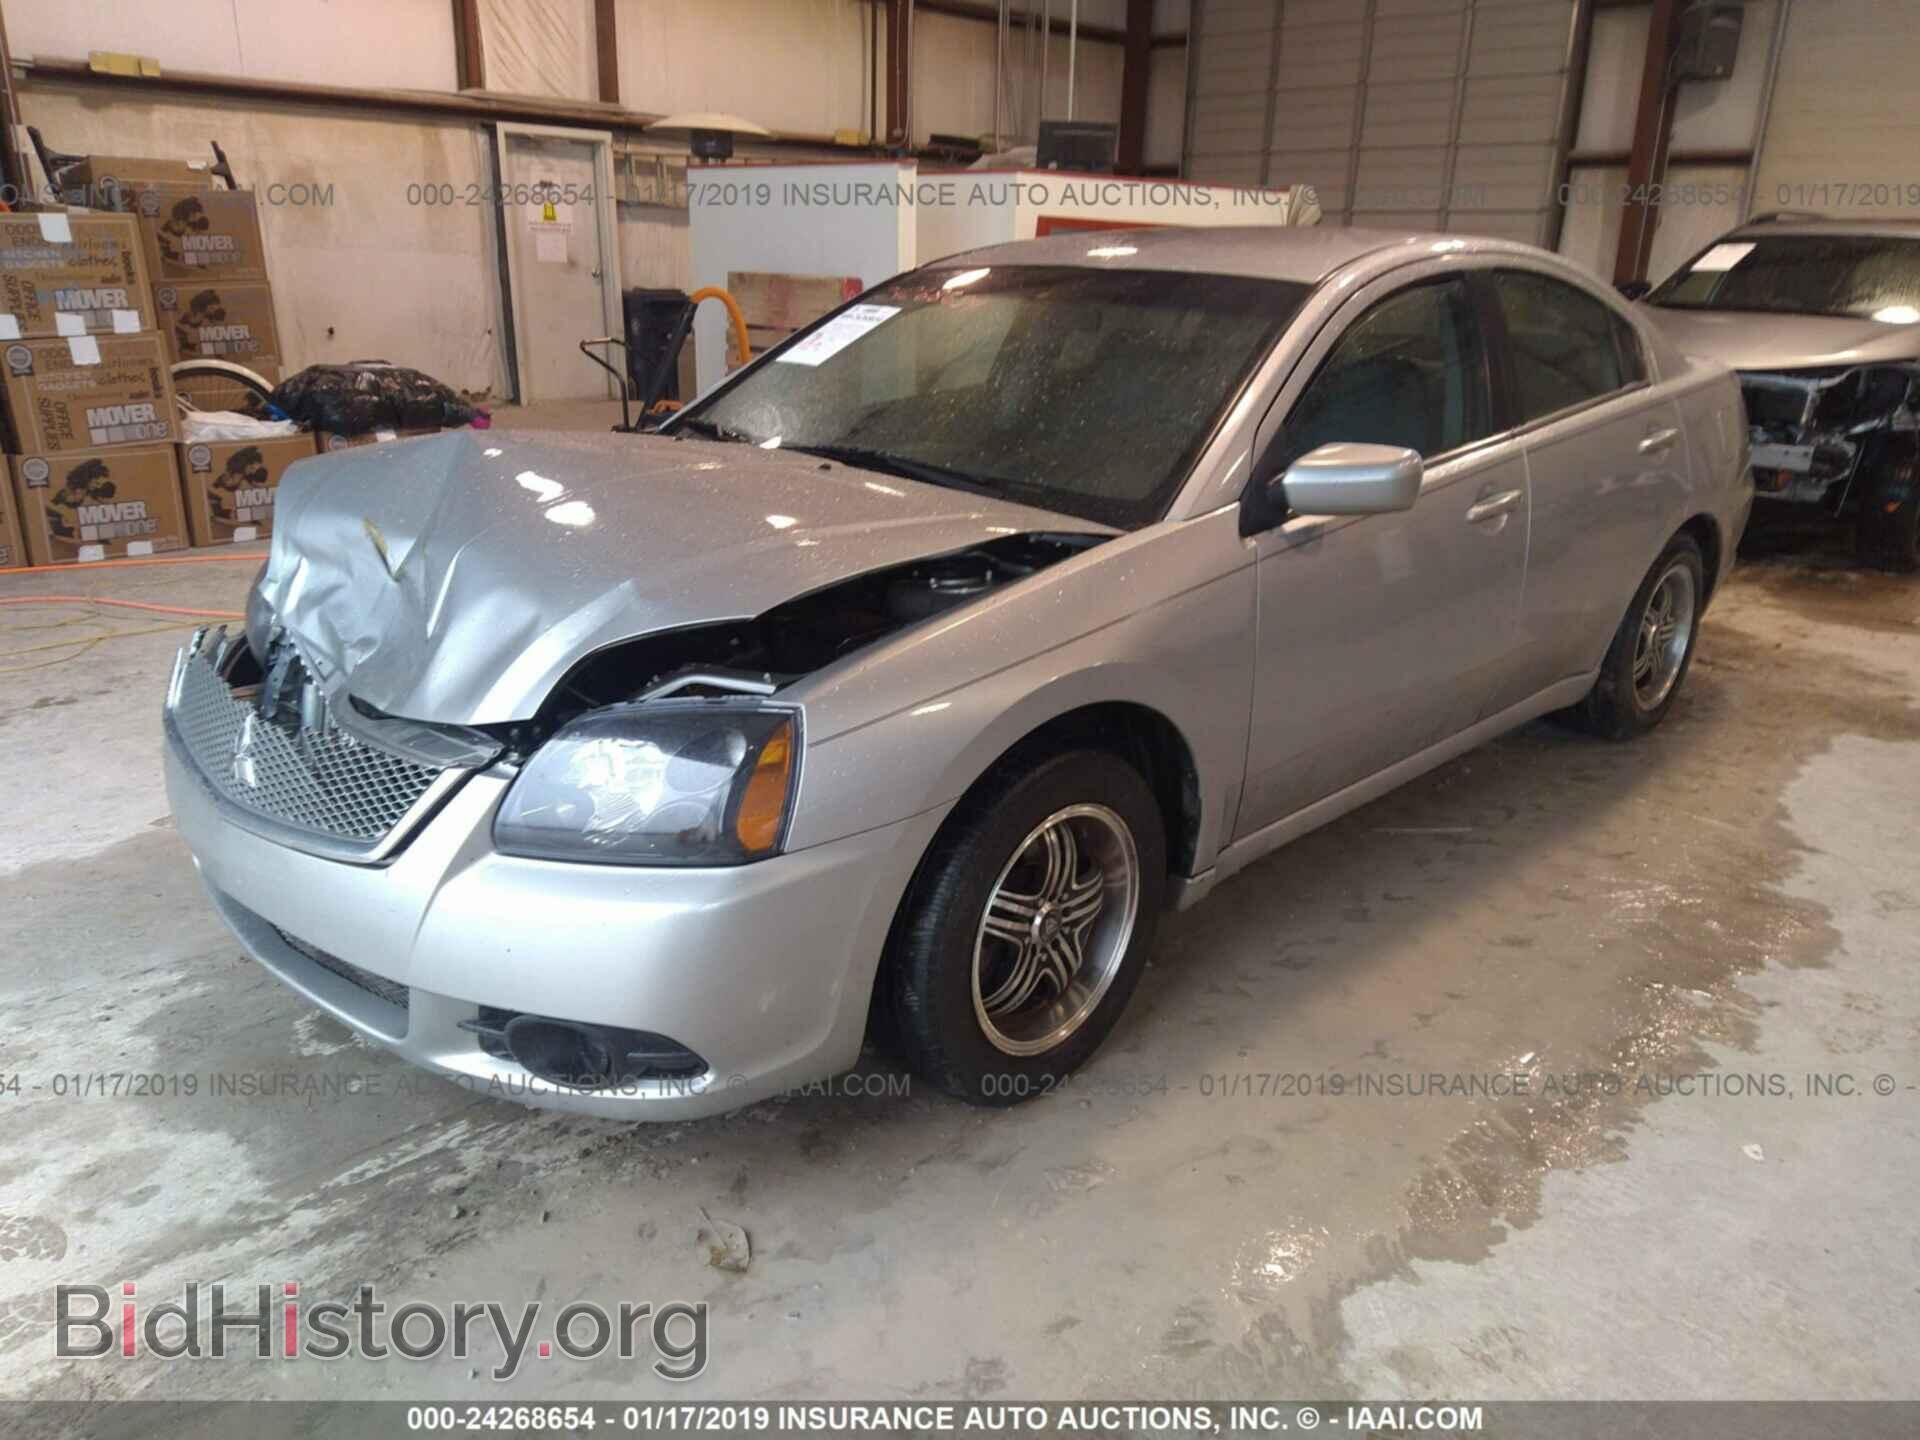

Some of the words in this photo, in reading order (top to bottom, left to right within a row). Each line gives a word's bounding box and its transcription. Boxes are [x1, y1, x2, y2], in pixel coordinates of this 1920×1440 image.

[55, 287, 129, 310] MOVER
[199, 324, 250, 341] MOVER
[86, 403, 157, 428] MOVER
[235, 487, 273, 508] MOV
[77, 500, 147, 525] MOVER
